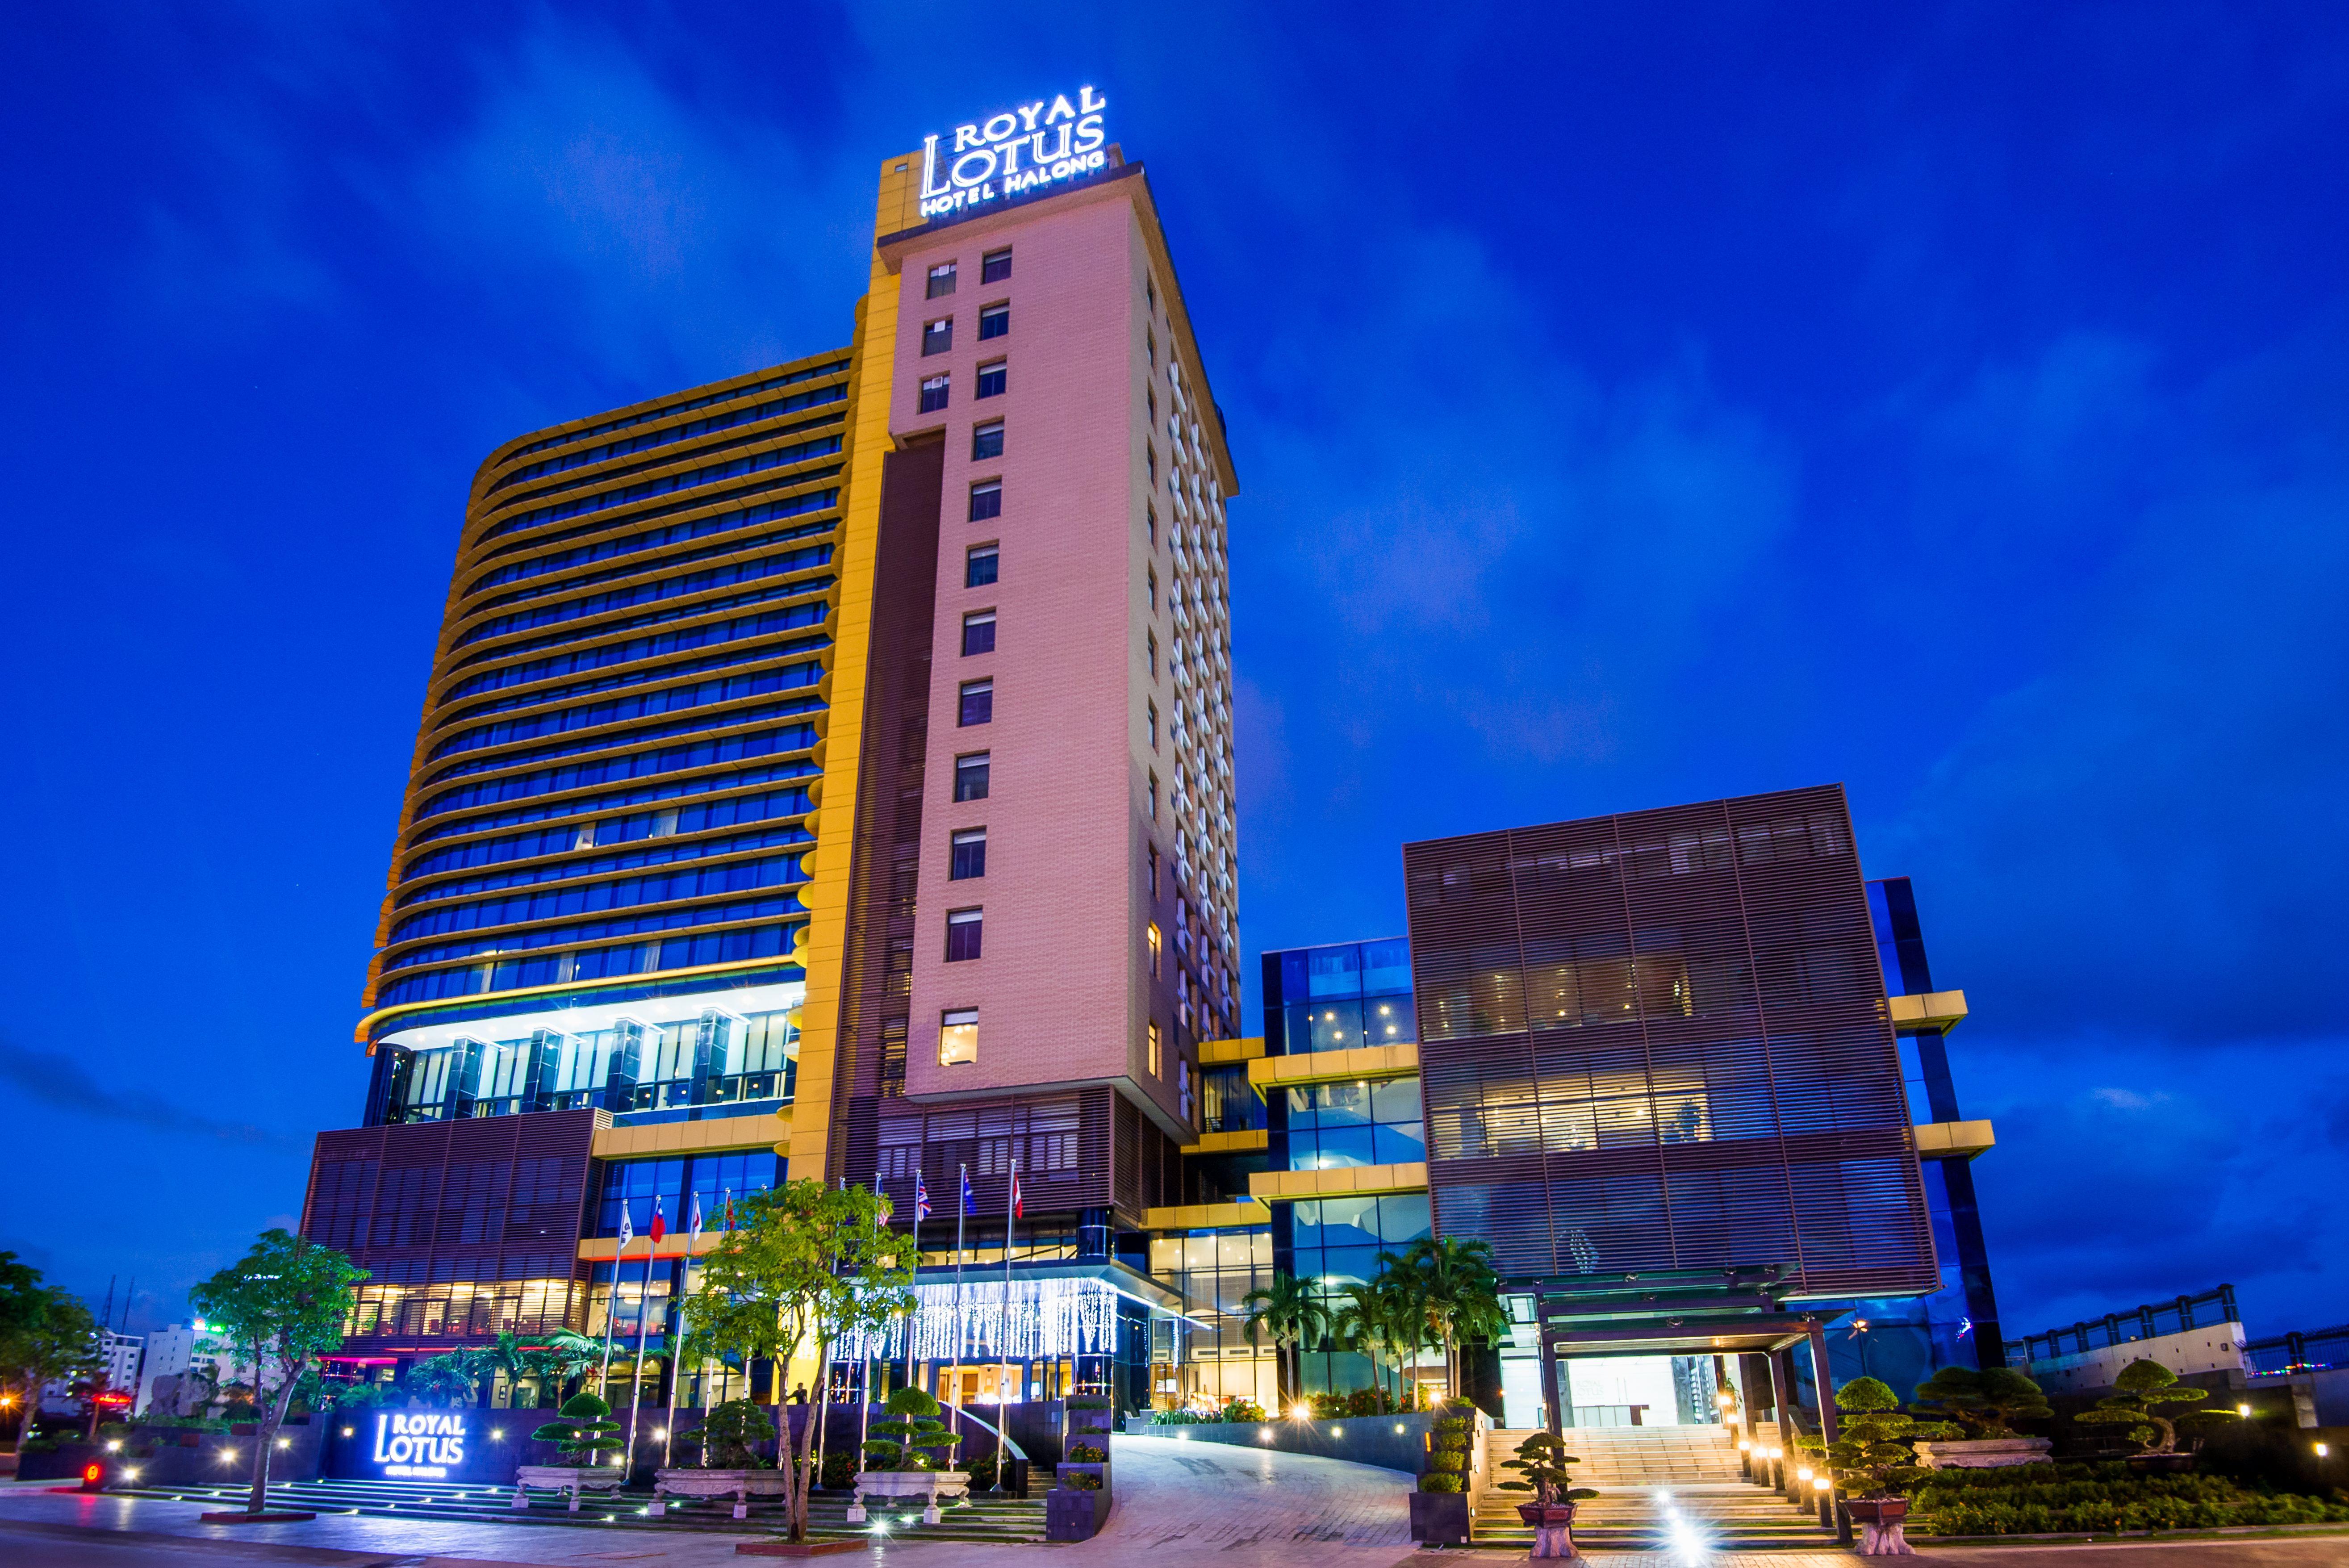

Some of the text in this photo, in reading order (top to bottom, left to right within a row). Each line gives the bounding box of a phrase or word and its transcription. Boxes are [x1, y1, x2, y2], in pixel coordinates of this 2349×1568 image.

[954, 87, 1105, 152] ROYAL
[920, 115, 1104, 199] LOTUS
[920, 151, 1104, 217] HOTEL HALONG
[374, 1414, 463, 1463] LOTUS
[393, 1414, 465, 1435] ROYAL
